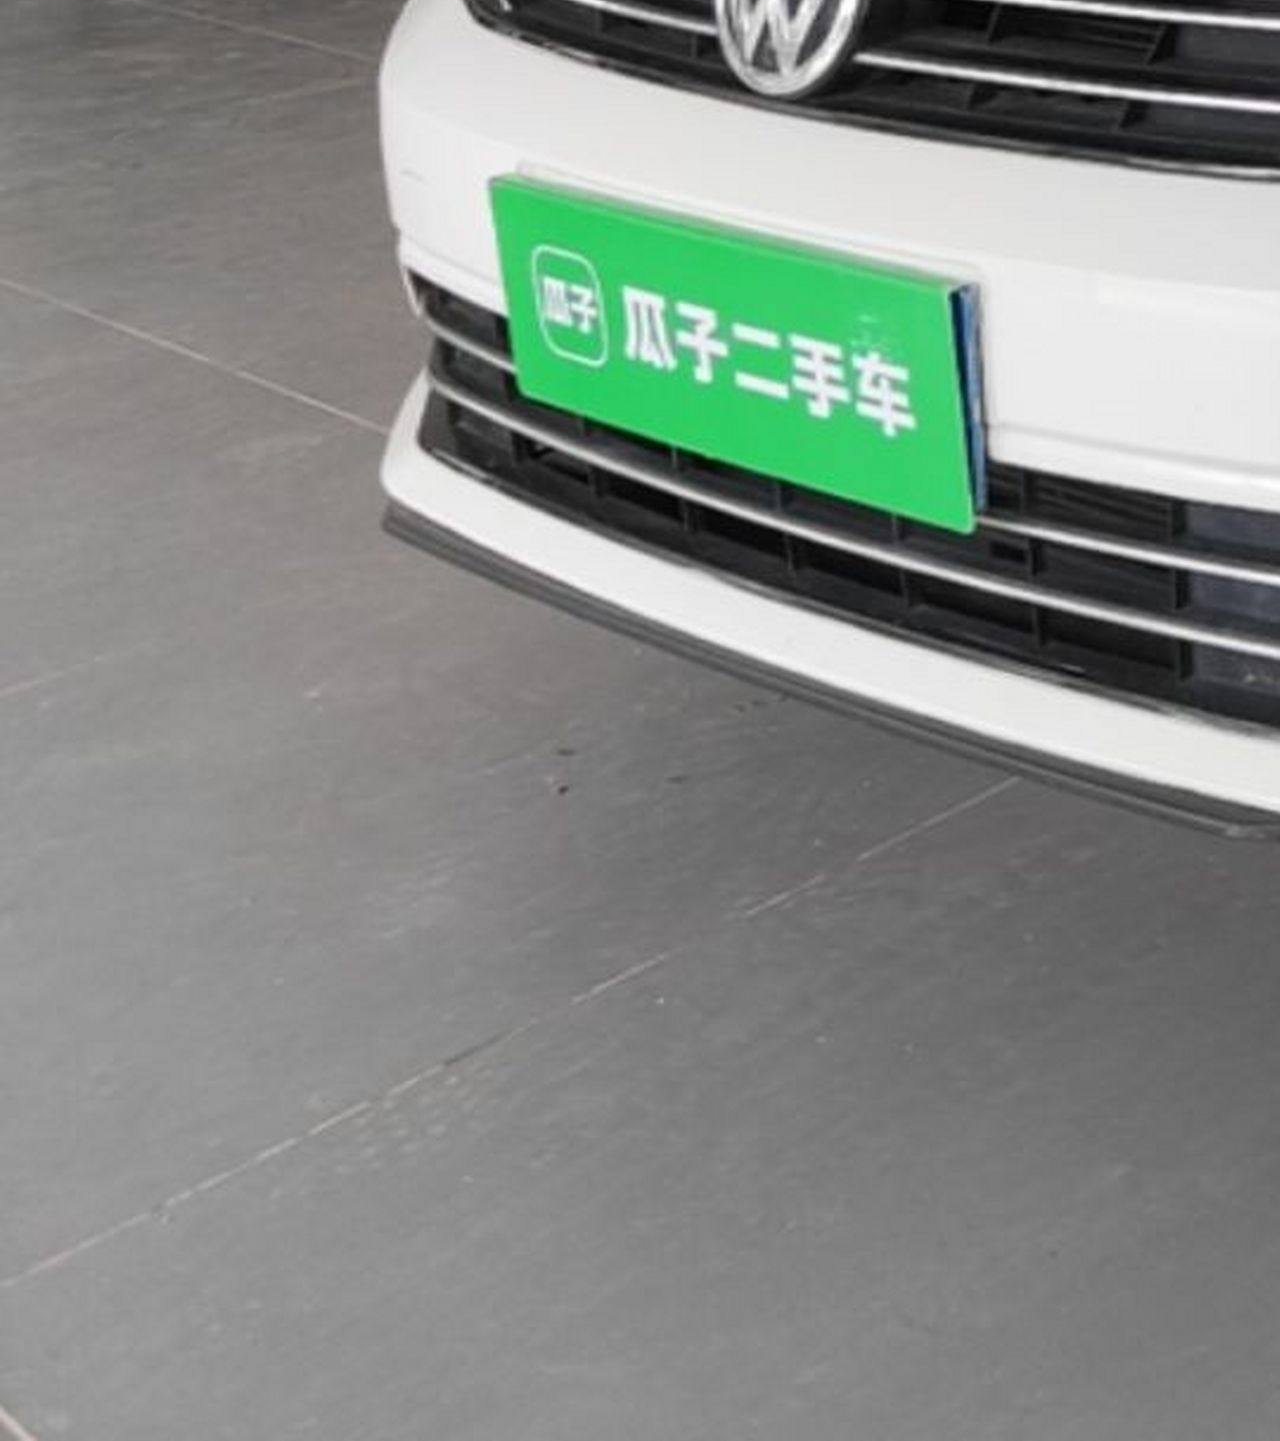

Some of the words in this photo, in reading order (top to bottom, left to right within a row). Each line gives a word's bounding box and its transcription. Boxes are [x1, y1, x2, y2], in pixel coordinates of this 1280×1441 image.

[541, 275, 599, 334] 瓜子
[621, 284, 918, 438] 瓜子二手车
